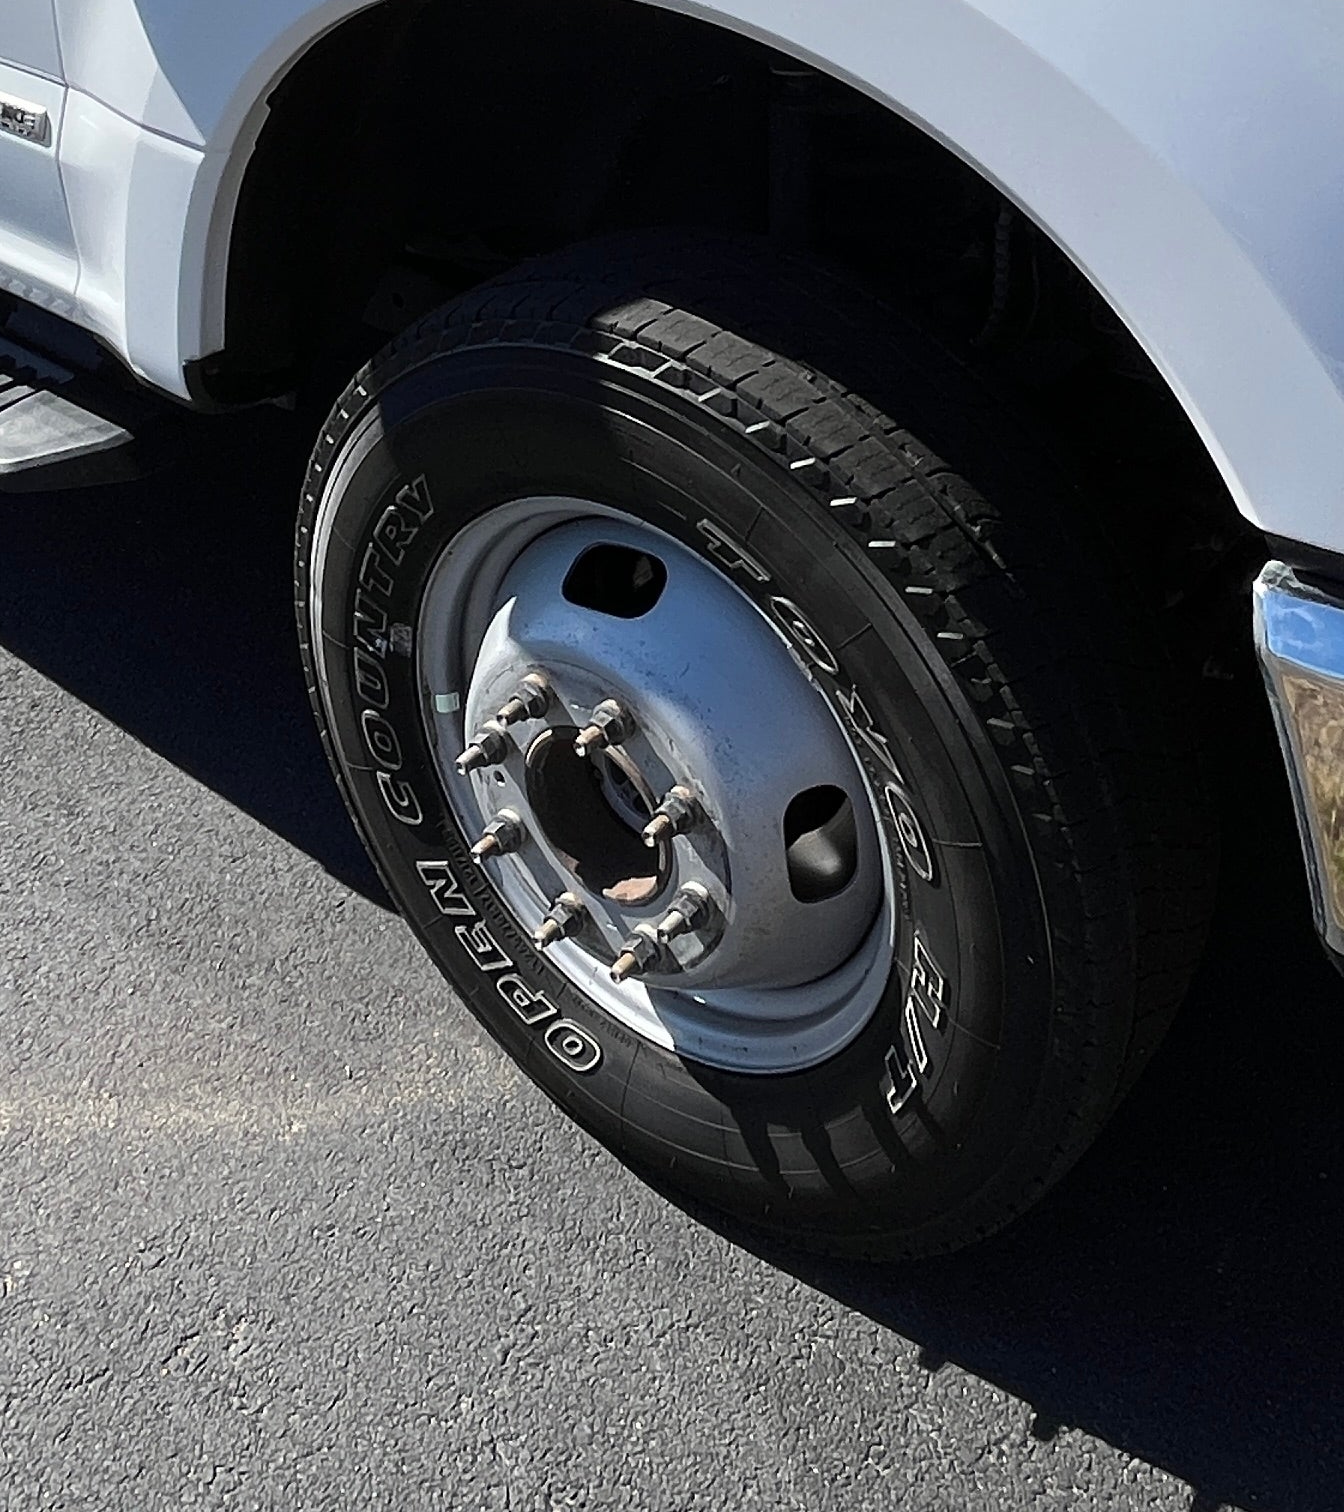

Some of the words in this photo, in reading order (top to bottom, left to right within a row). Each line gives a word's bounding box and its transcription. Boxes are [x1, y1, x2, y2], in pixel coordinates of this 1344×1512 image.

[351, 472, 436, 827] COUNTRY
[696, 518, 935, 883] TOYO
[415, 859, 603, 1074] OPEN
